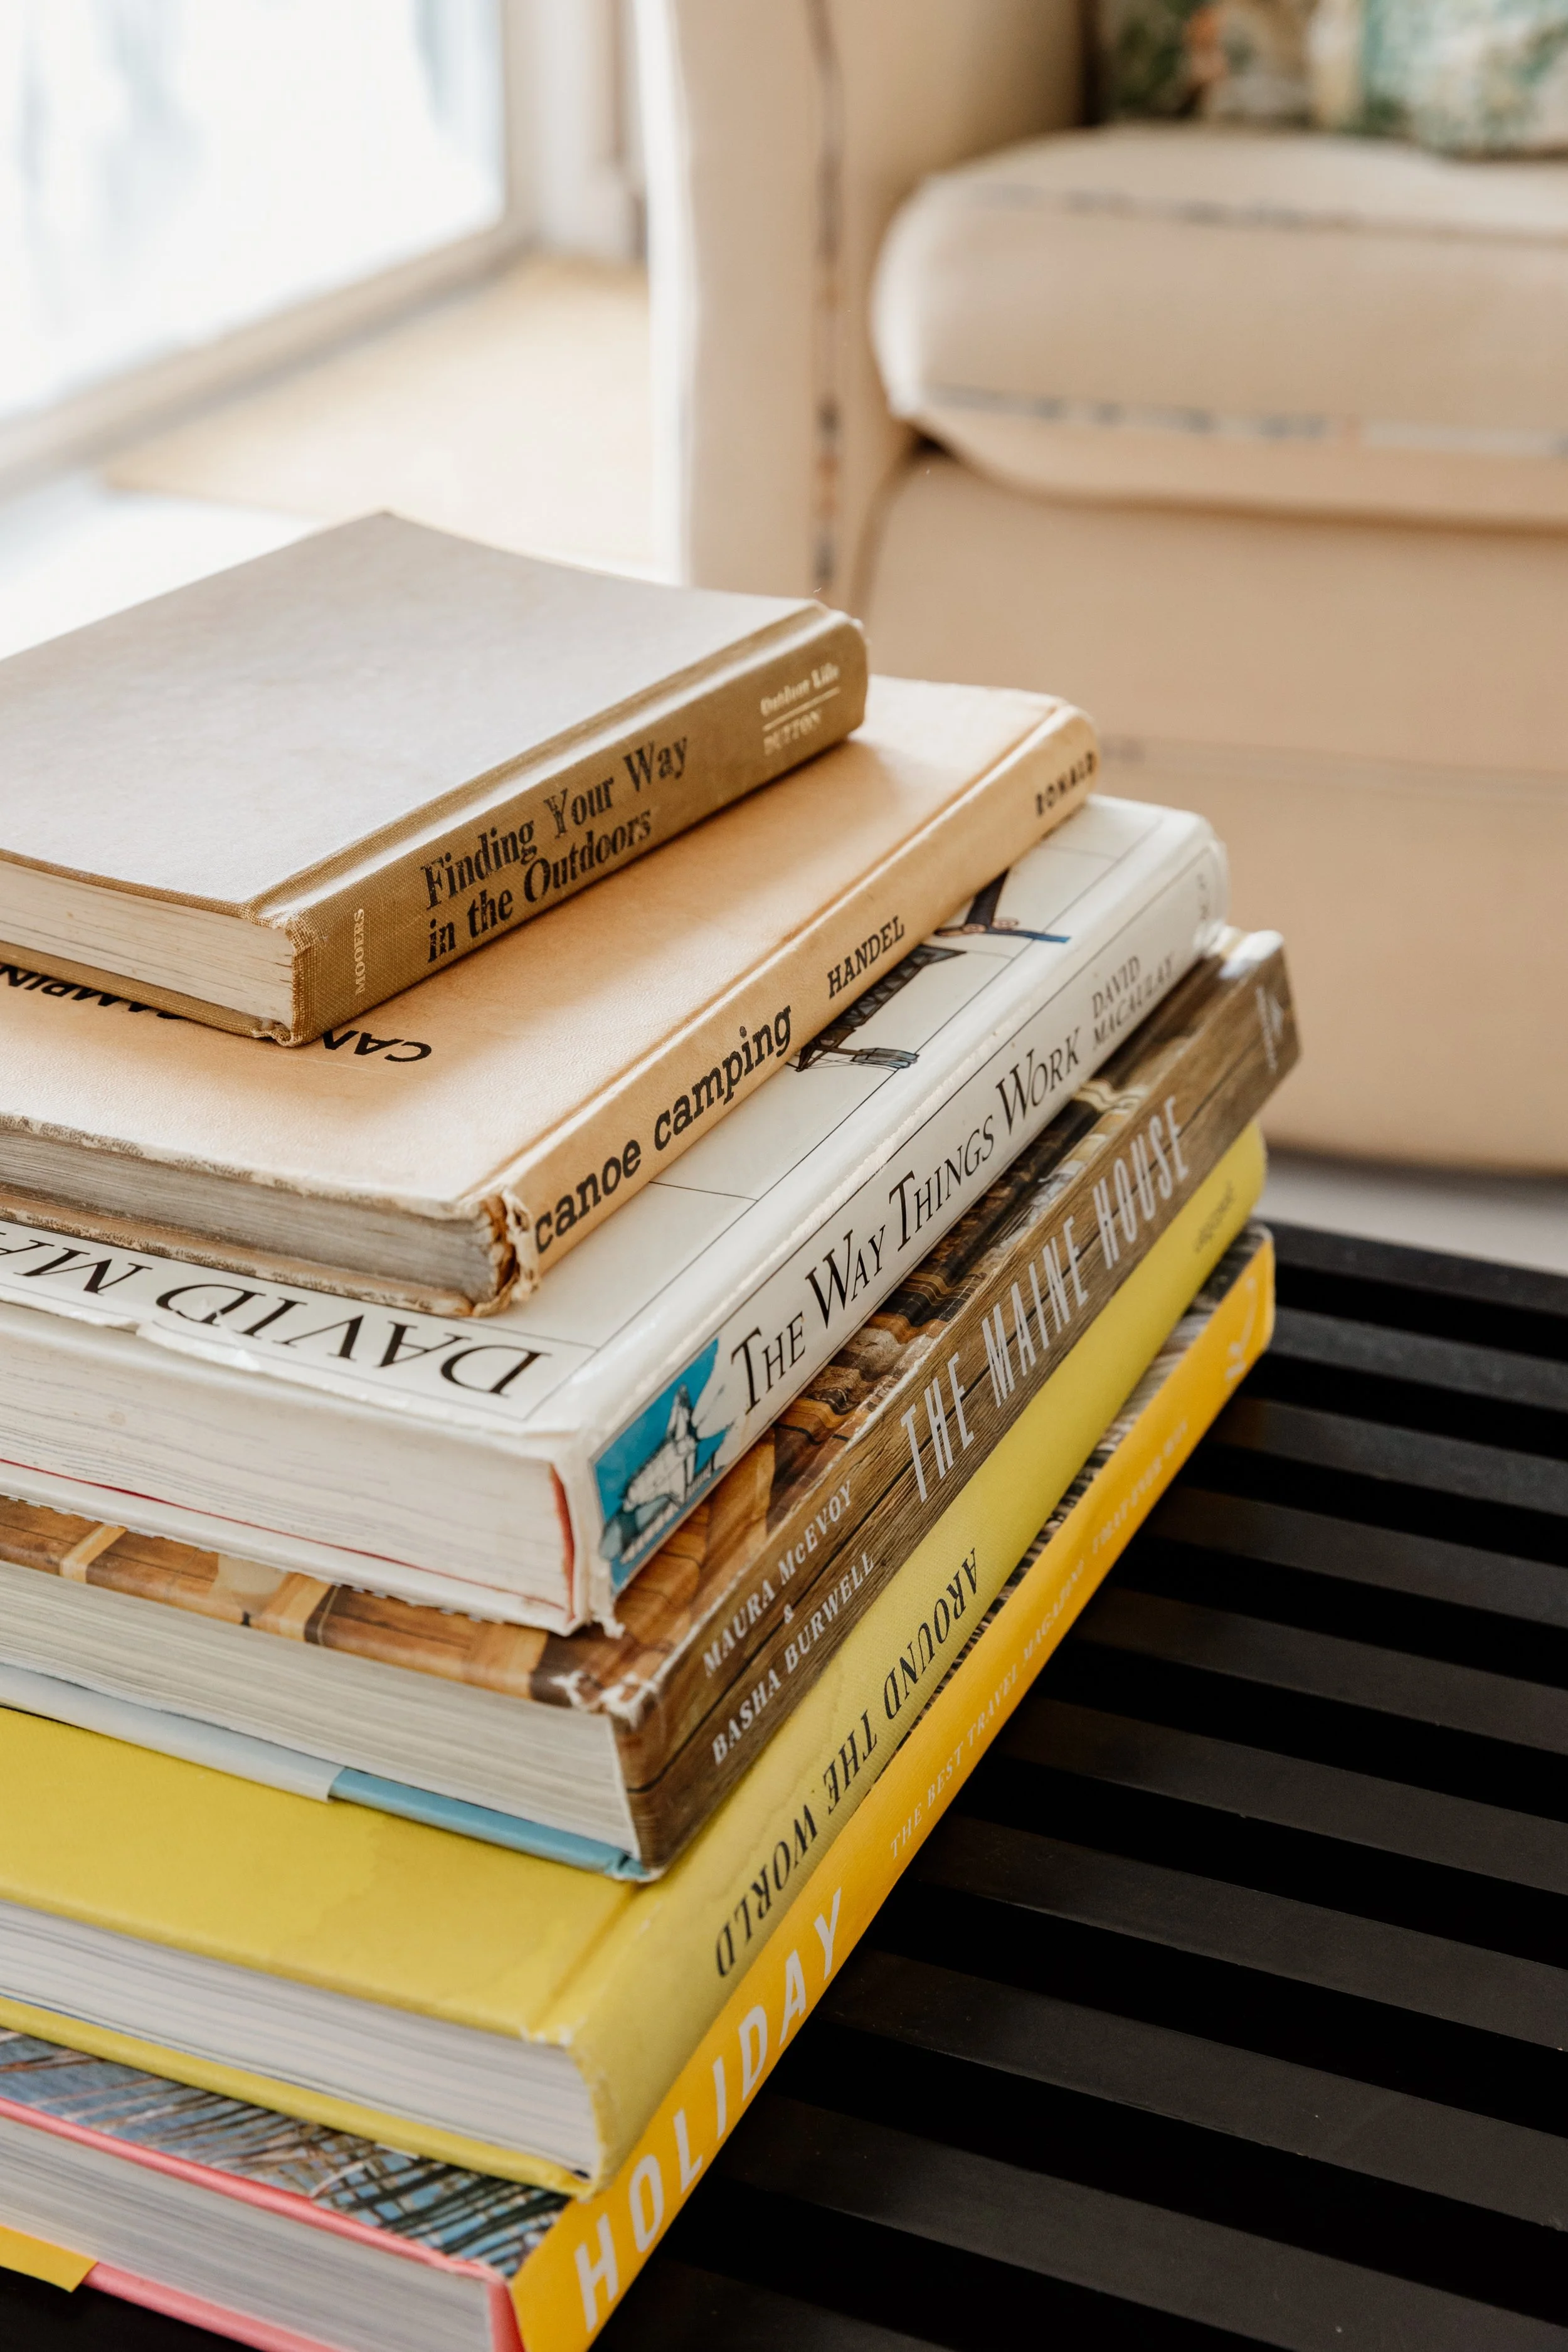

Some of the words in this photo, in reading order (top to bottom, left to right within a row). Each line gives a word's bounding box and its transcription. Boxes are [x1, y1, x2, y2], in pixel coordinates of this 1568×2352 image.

[421, 820, 538, 910] Finding
[543, 777, 614, 839] Your
[623, 737, 687, 792] Way
[427, 918, 457, 963] in
[467, 888, 513, 938] the
[524, 809, 652, 903] Outdoors
[354, 908, 366, 995] MOOERS
[827, 916, 905, 999] HANDEL
[1091, 955, 1140, 1019] DAVID
[534, 1140, 641, 1254] canoe
[654, 1006, 792, 1152] camping
[731, 1311, 807, 1416] THE
[805, 1229, 886, 1329] WAY
[889, 1115, 994, 1253] THINGS
[995, 1025, 1081, 1136] WORK
[900, 1353, 974, 1503] THE
[982, 1216, 1089, 1409] MAINE
[1093, 1096, 1189, 1269] HOUSE
[156, 1283, 552, 1399] DAVID
[702, 1579, 776, 1678] MAURA
[777, 1480, 852, 1585] McEVOY
[711, 1668, 782, 1765] BASHA
[784, 1552, 876, 1675] BURWELL
[784, 1603, 795, 1624] &
[883, 1547, 978, 1722] AROUND
[823, 1709, 878, 1814] THE
[890, 1802, 923, 1860] THE
[927, 1741, 965, 1811] BEST
[967, 1660, 1018, 1751] TRAVEL
[716, 1803, 818, 1978] WORLD
[574, 1887, 841, 2333] HOLIDAY
